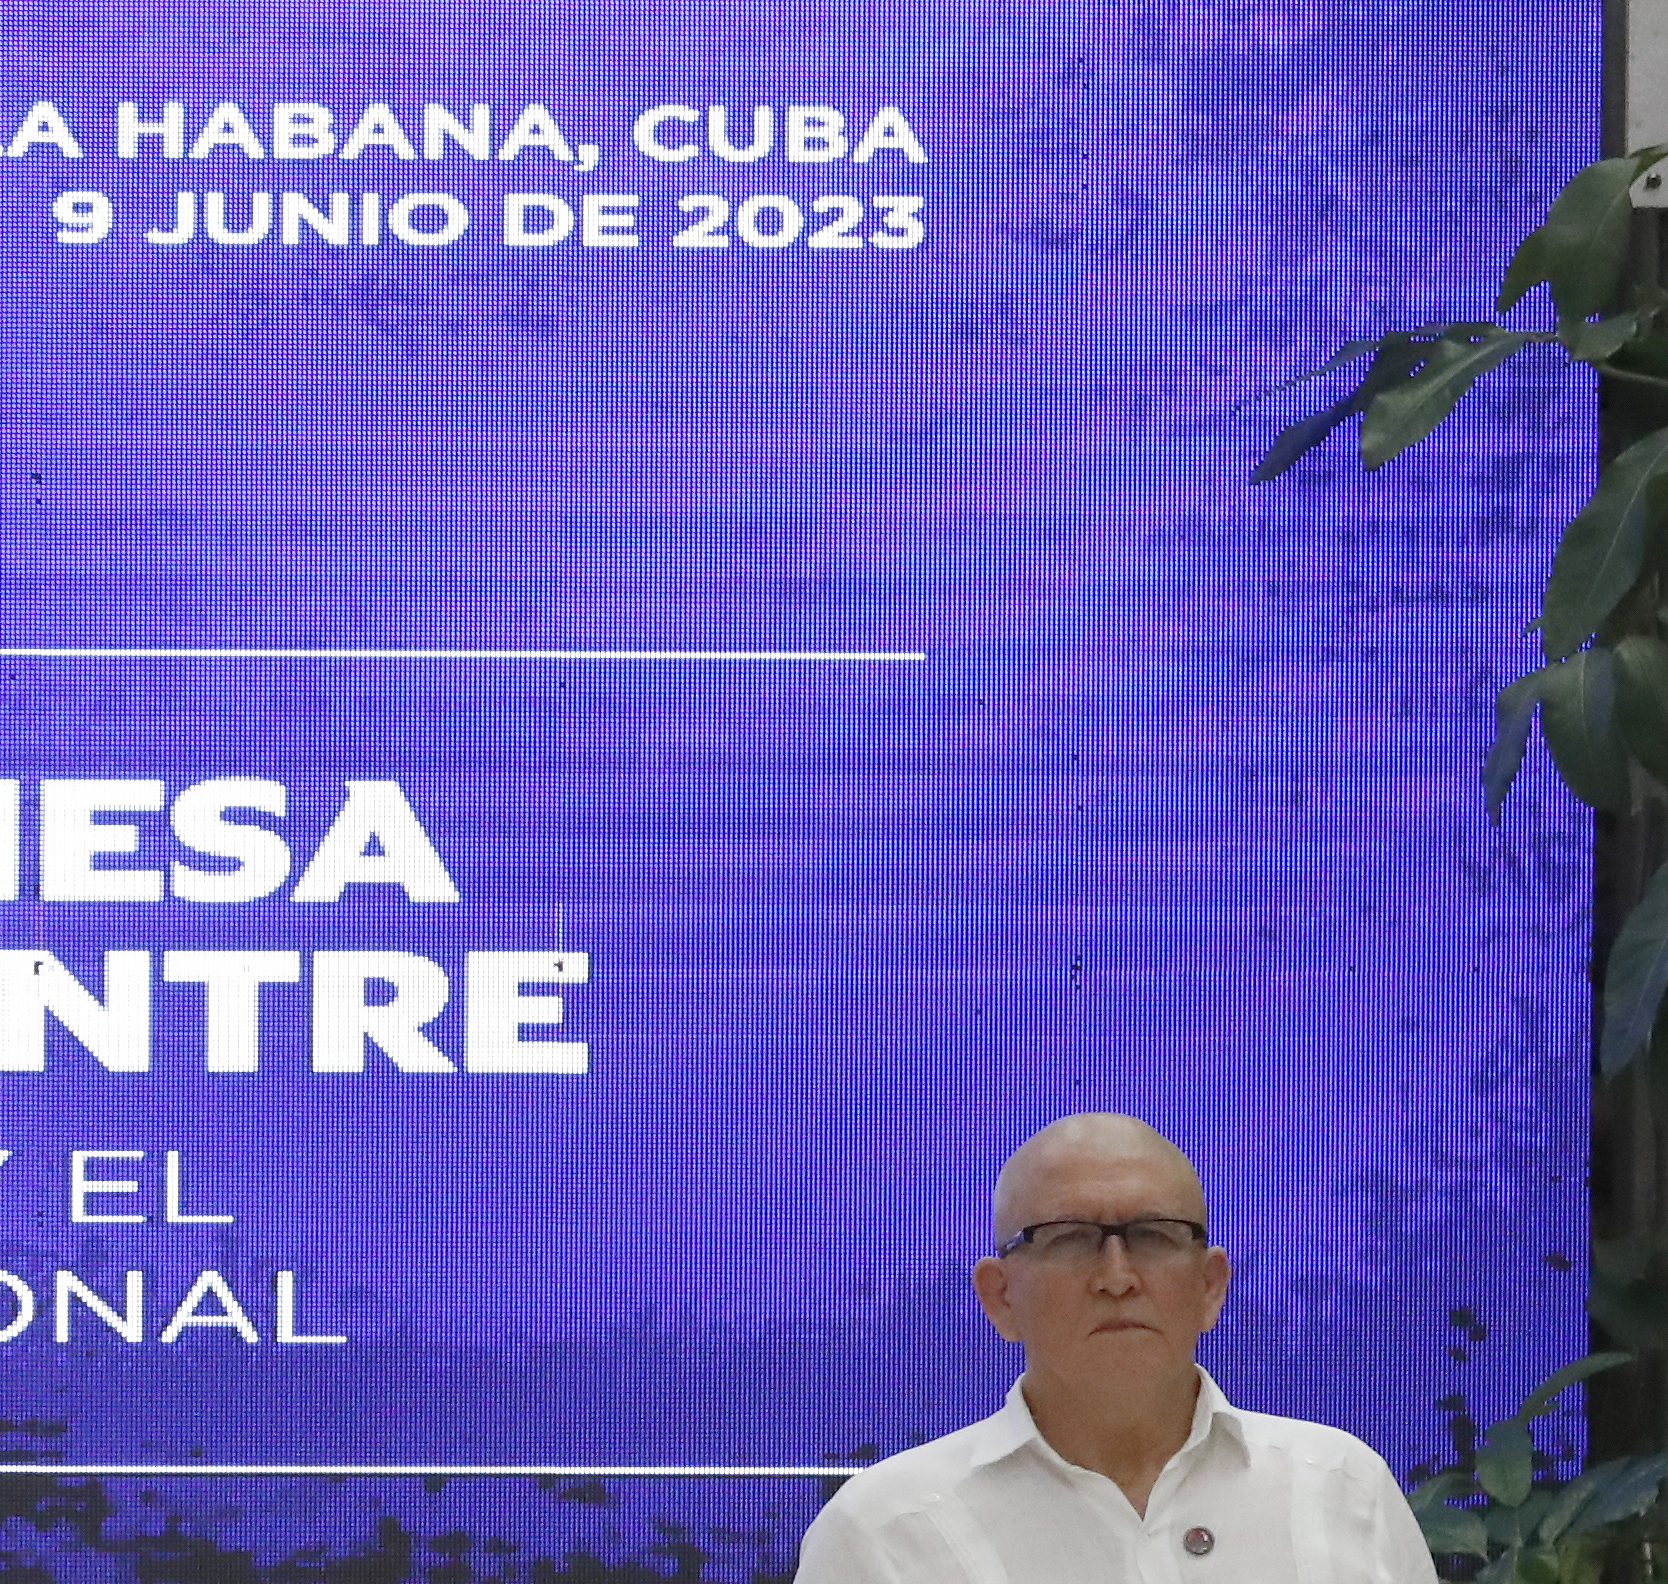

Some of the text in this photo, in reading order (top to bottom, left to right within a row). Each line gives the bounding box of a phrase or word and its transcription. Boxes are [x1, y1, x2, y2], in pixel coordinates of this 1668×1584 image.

[115, 100, 601, 171] HABANA,
[631, 103, 928, 164] CUBA
[50, 188, 926, 250] 9 JUNIO DE 2023
[69, 1148, 236, 1224] EL
